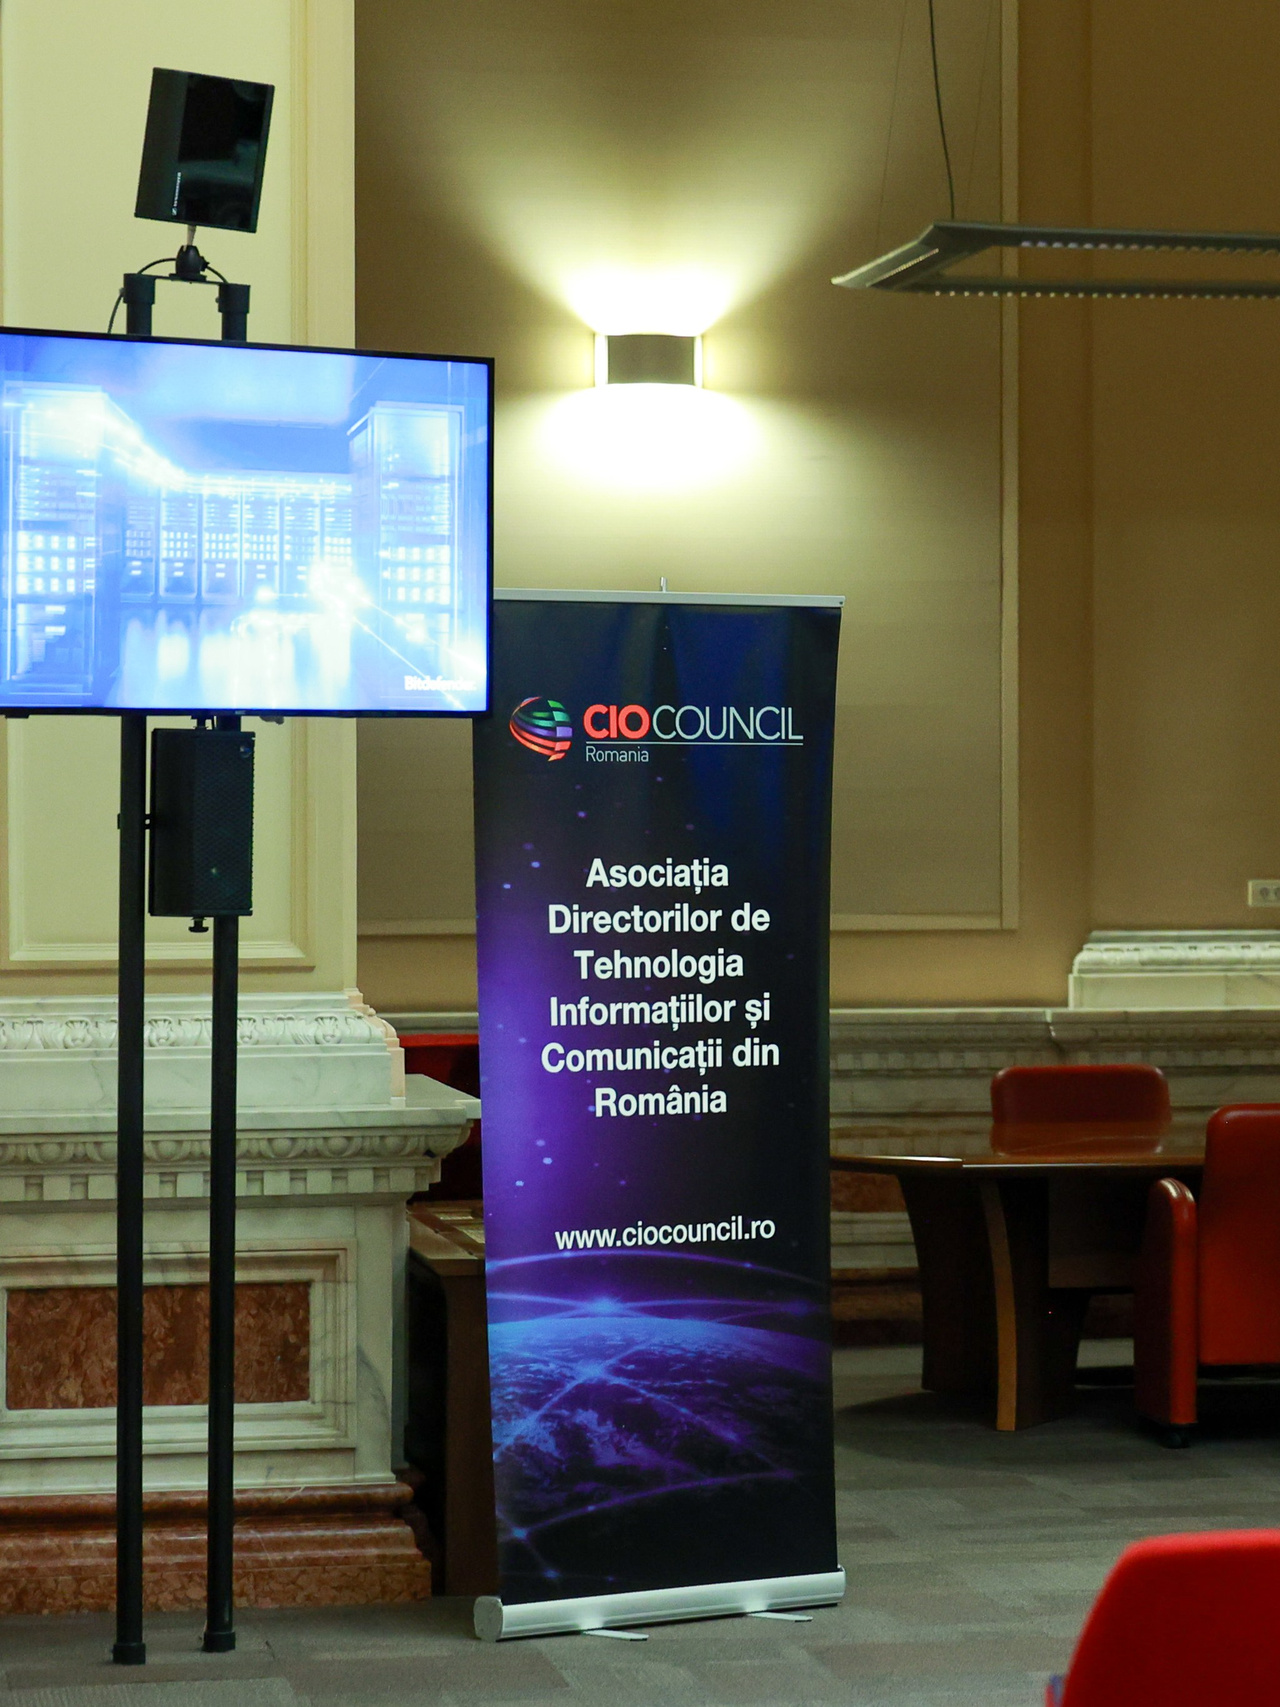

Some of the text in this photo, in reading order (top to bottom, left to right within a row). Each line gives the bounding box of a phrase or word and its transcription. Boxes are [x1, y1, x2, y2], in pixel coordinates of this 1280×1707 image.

[585, 745, 649, 762] Romania
[585, 857, 730, 895] Asociația
[548, 902, 771, 935] Directorilor de
[573, 948, 744, 985] Tehnologia
[550, 992, 771, 1031] Informațiilor și
[541, 1037, 780, 1076] Comunicații din
[595, 1084, 728, 1118] România
[554, 1215, 776, 1250] www.ciocouncil.ro
